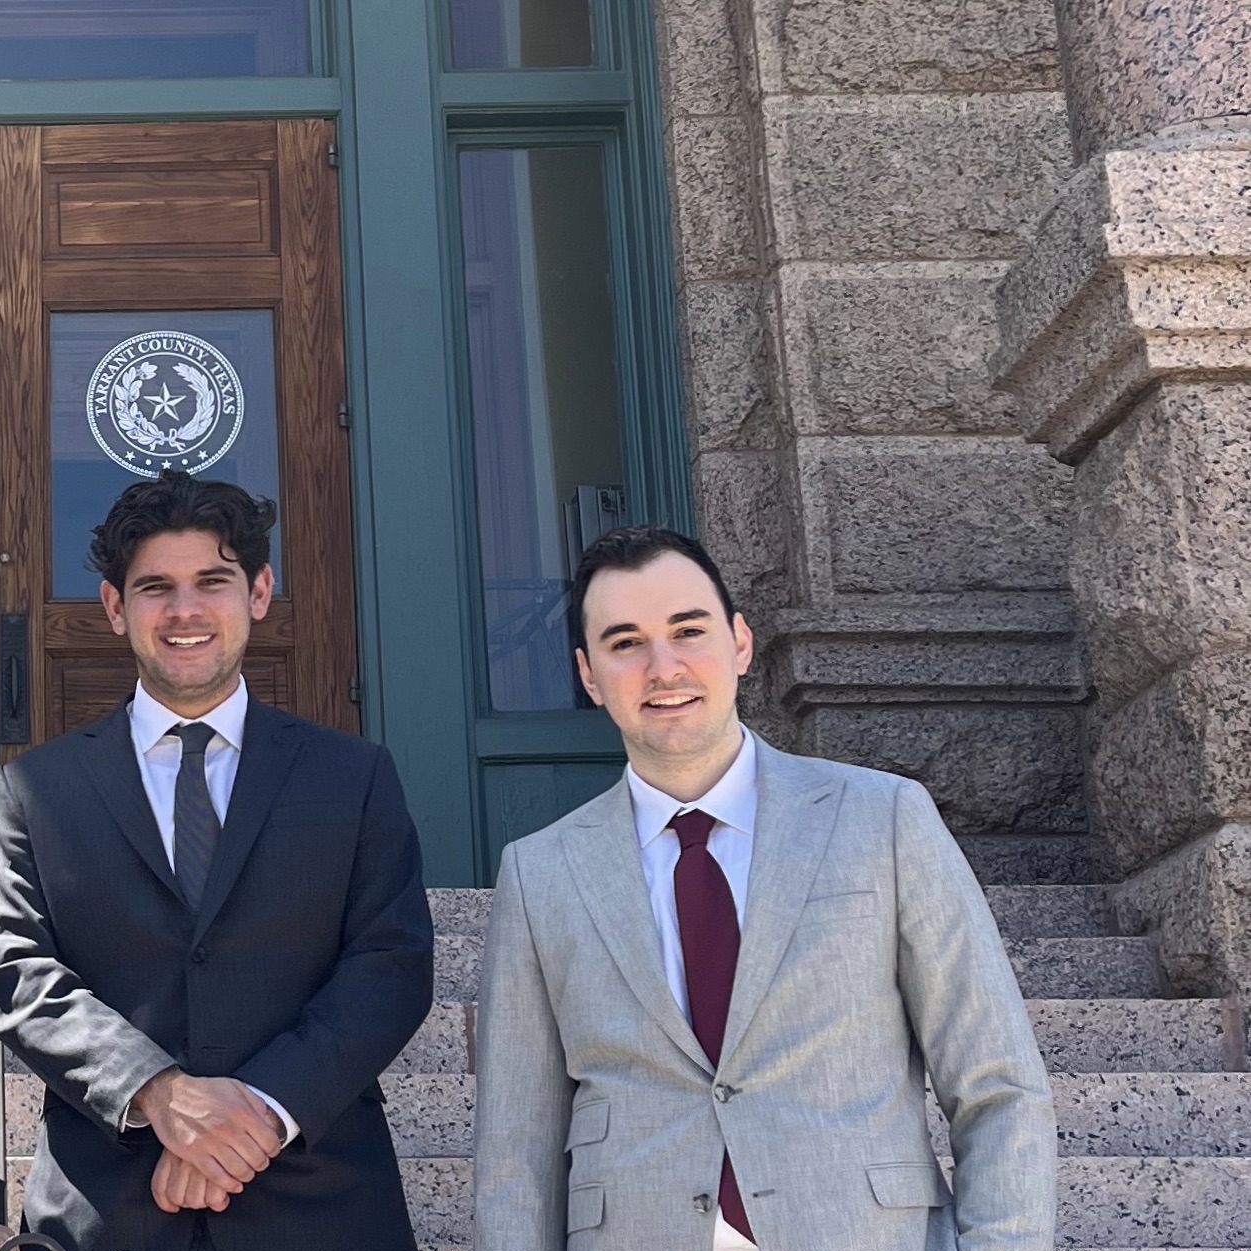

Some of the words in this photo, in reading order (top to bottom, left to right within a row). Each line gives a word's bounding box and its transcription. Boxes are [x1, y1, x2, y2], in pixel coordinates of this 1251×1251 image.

[94, 347, 135, 417] TARRANT
[138, 338, 208, 366] COUNTY,
[209, 362, 235, 415] TEXAS
